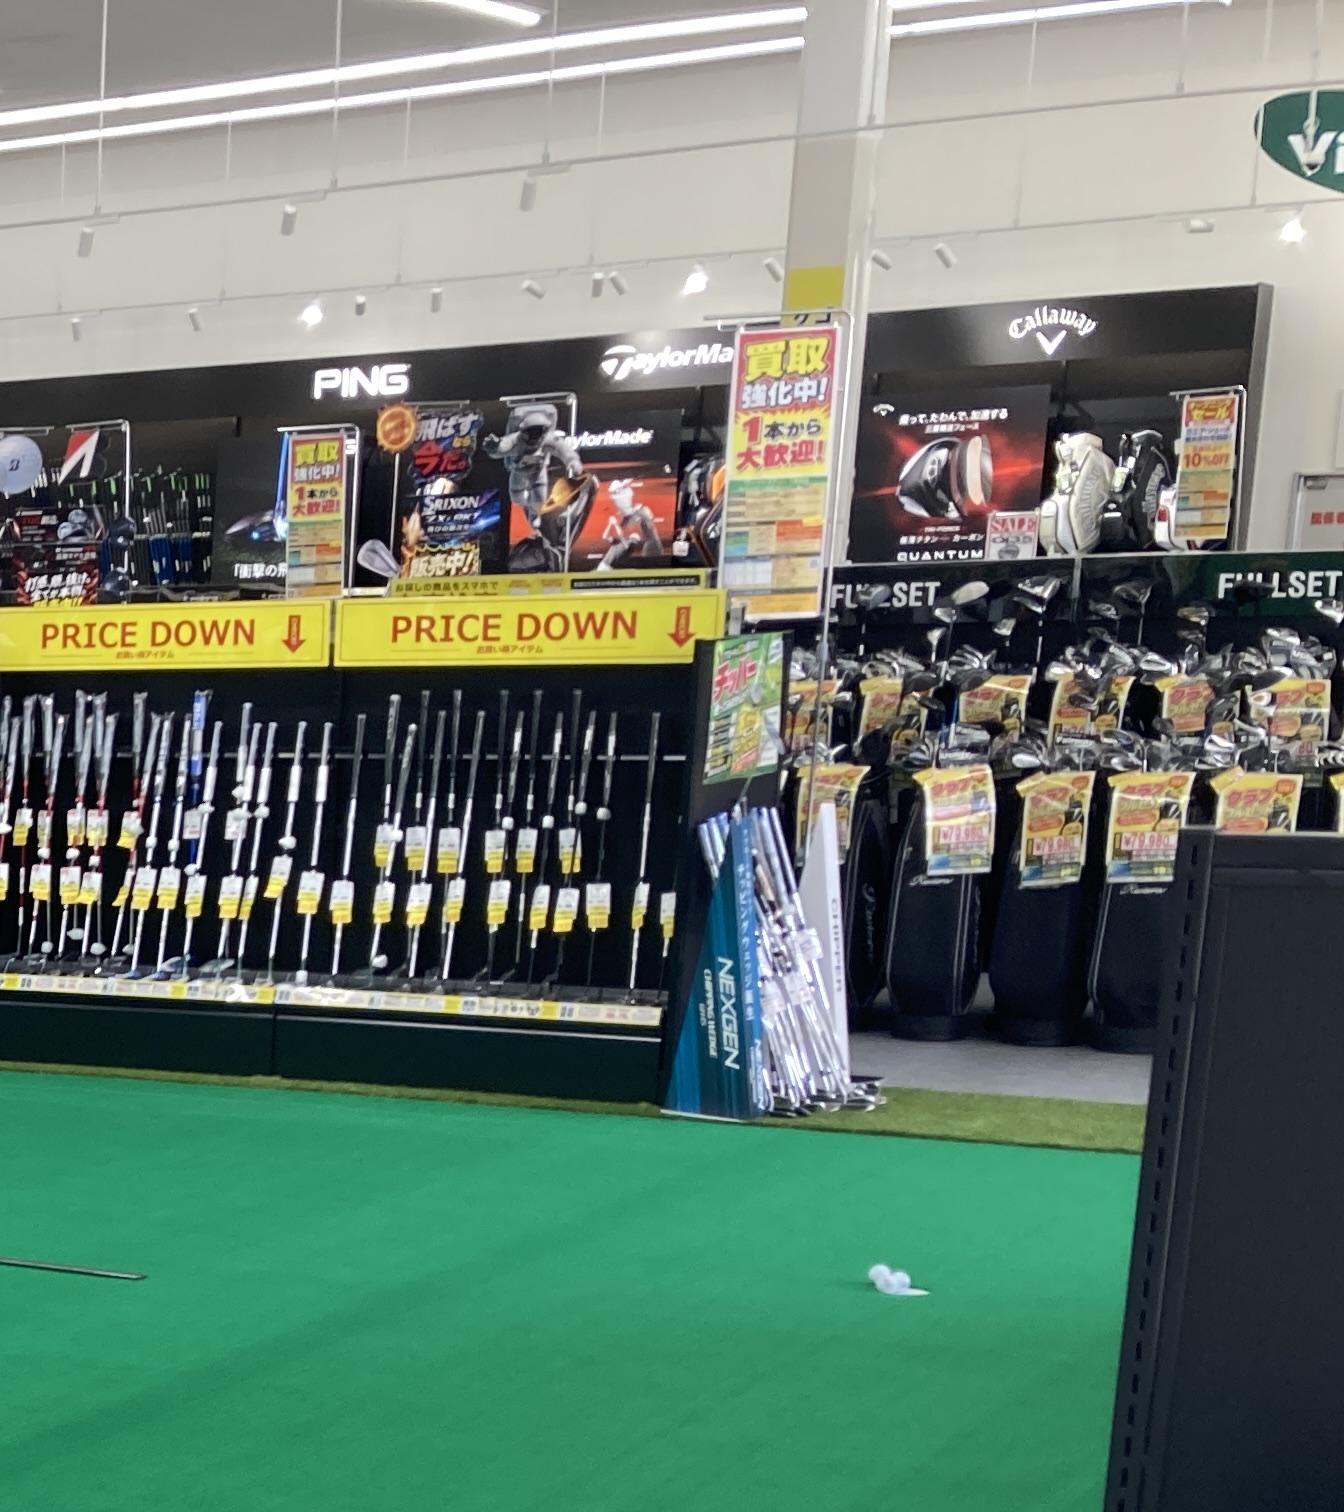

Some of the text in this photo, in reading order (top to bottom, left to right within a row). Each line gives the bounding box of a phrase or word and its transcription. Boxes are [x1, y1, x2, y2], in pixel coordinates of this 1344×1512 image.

[1009, 305, 1098, 339] Callaway
[600, 344, 734, 380] TaylorMa
[745, 338, 829, 381] 買取
[314, 363, 411, 398] PING
[742, 377, 828, 409] 強化中!
[742, 416, 821, 445] 1本から
[737, 440, 825, 472] 大歓迎!
[423, 495, 480, 515] SRIXON
[991, 517, 1036, 533] SALE
[897, 550, 984, 562] QUANTUM
[830, 581, 942, 609] FUSET
[41, 619, 256, 649] PRICE DOWN
[392, 611, 637, 643] PRICE DOWN
[717, 956, 740, 1070] NEXGEN
